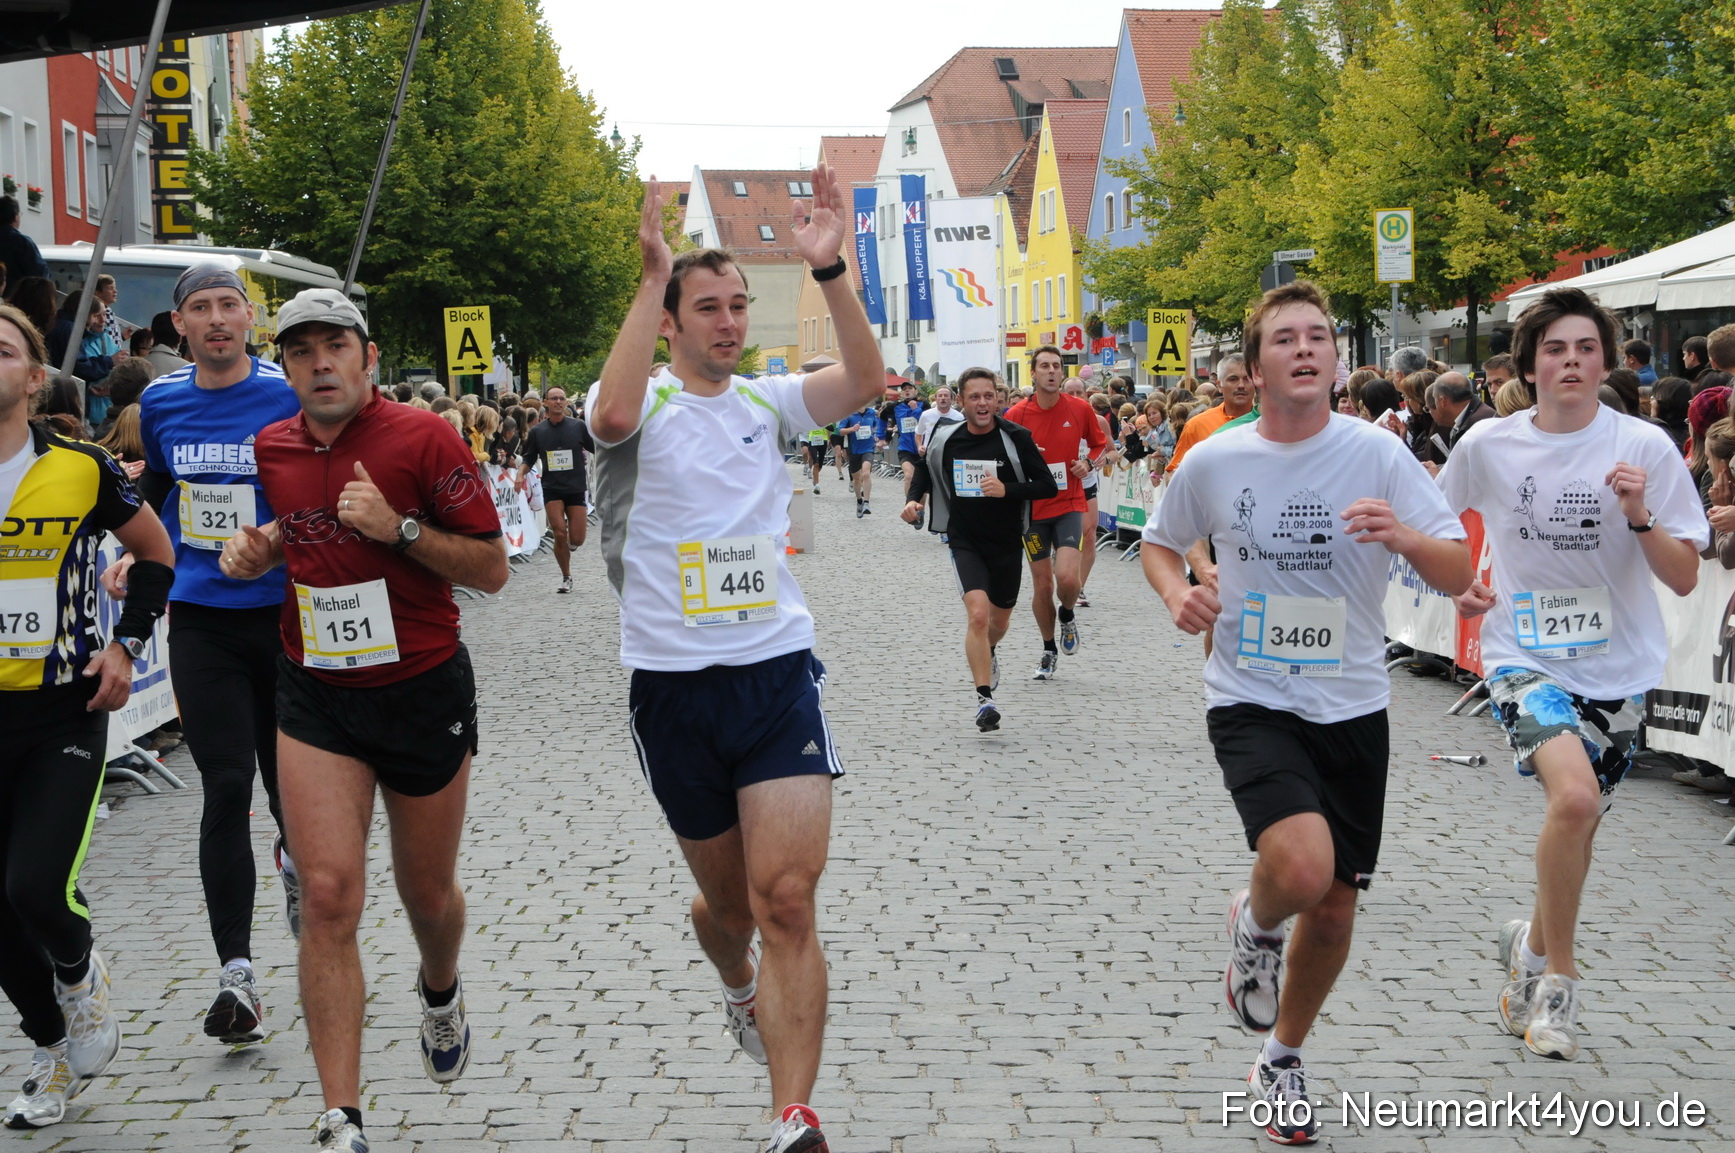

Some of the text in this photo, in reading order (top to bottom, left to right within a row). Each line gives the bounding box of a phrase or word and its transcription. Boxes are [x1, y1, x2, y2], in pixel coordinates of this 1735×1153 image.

[914, 228, 925, 278] RUPPERT
[449, 309, 485, 323] Block
[1153, 311, 1187, 325] Block
[456, 327, 483, 361] A
[1156, 329, 1182, 362] A
[173, 443, 256, 465] HUBER
[556, 457, 569, 465] 367
[188, 463, 254, 474] TECHNOLOGY
[965, 463, 984, 471] Roland
[192, 489, 233, 504] Michael
[1554, 507, 1601, 515] 21.09.2008
[201, 511, 239, 530] 321
[1278, 520, 1333, 530] 21.09.2008
[1537, 531, 1600, 542] Neumarkter
[1553, 541, 1600, 551] Stadtlauf
[707, 544, 756, 564] Michael
[1238, 547, 1333, 562] 9. Neumarkter
[1276, 560, 1333, 571] Stadtlauf
[685, 575, 692, 588] B
[720, 570, 765, 596] 446
[312, 592, 361, 612] Michael
[1541, 596, 1578, 610] Fabian
[326, 617, 372, 643] 151
[1522, 619, 1529, 630] B
[1545, 611, 1603, 637] 2174
[1270, 626, 1332, 648] 3460
[356, 649, 397, 662] PFLEIDERER
[1301, 664, 1340, 672] PFLEIDERER
